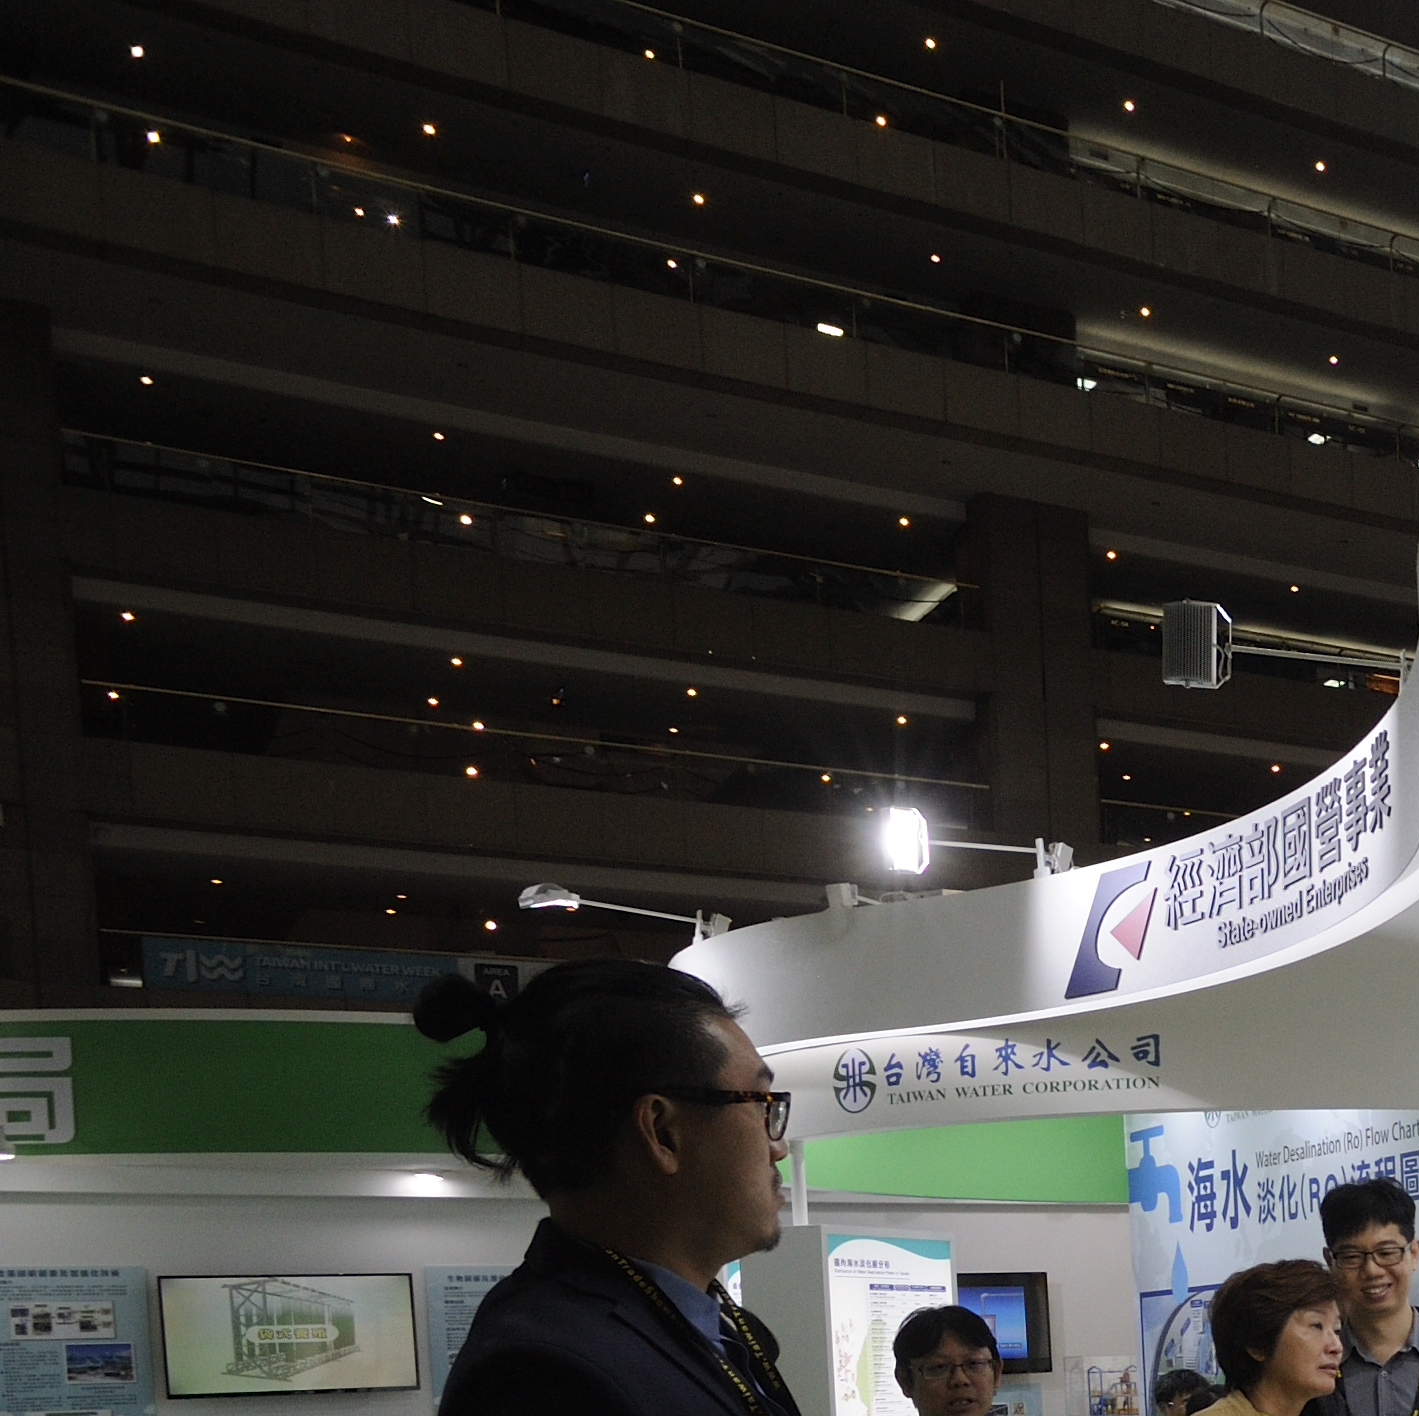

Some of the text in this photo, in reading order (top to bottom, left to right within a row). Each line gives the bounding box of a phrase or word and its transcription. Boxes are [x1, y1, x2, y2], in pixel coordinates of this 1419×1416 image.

[1164, 730, 1392, 931] 經濟部國營事業
[1217, 856, 1370, 949] State-owned Enterprises
[482, 966, 512, 977] AREA
[488, 979, 508, 998] A
[883, 1033, 1161, 1087] 台灣自來水公司
[887, 1075, 1161, 1106] TAIWAN WATER CORPORATION
[1255, 1150, 1281, 1169] Water
[1283, 1136, 1341, 1164] Desalination
[1343, 1129, 1364, 1155] (Ro)
[1365, 1124, 1389, 1148] Flow
[1187, 1149, 1251, 1233] 海水
